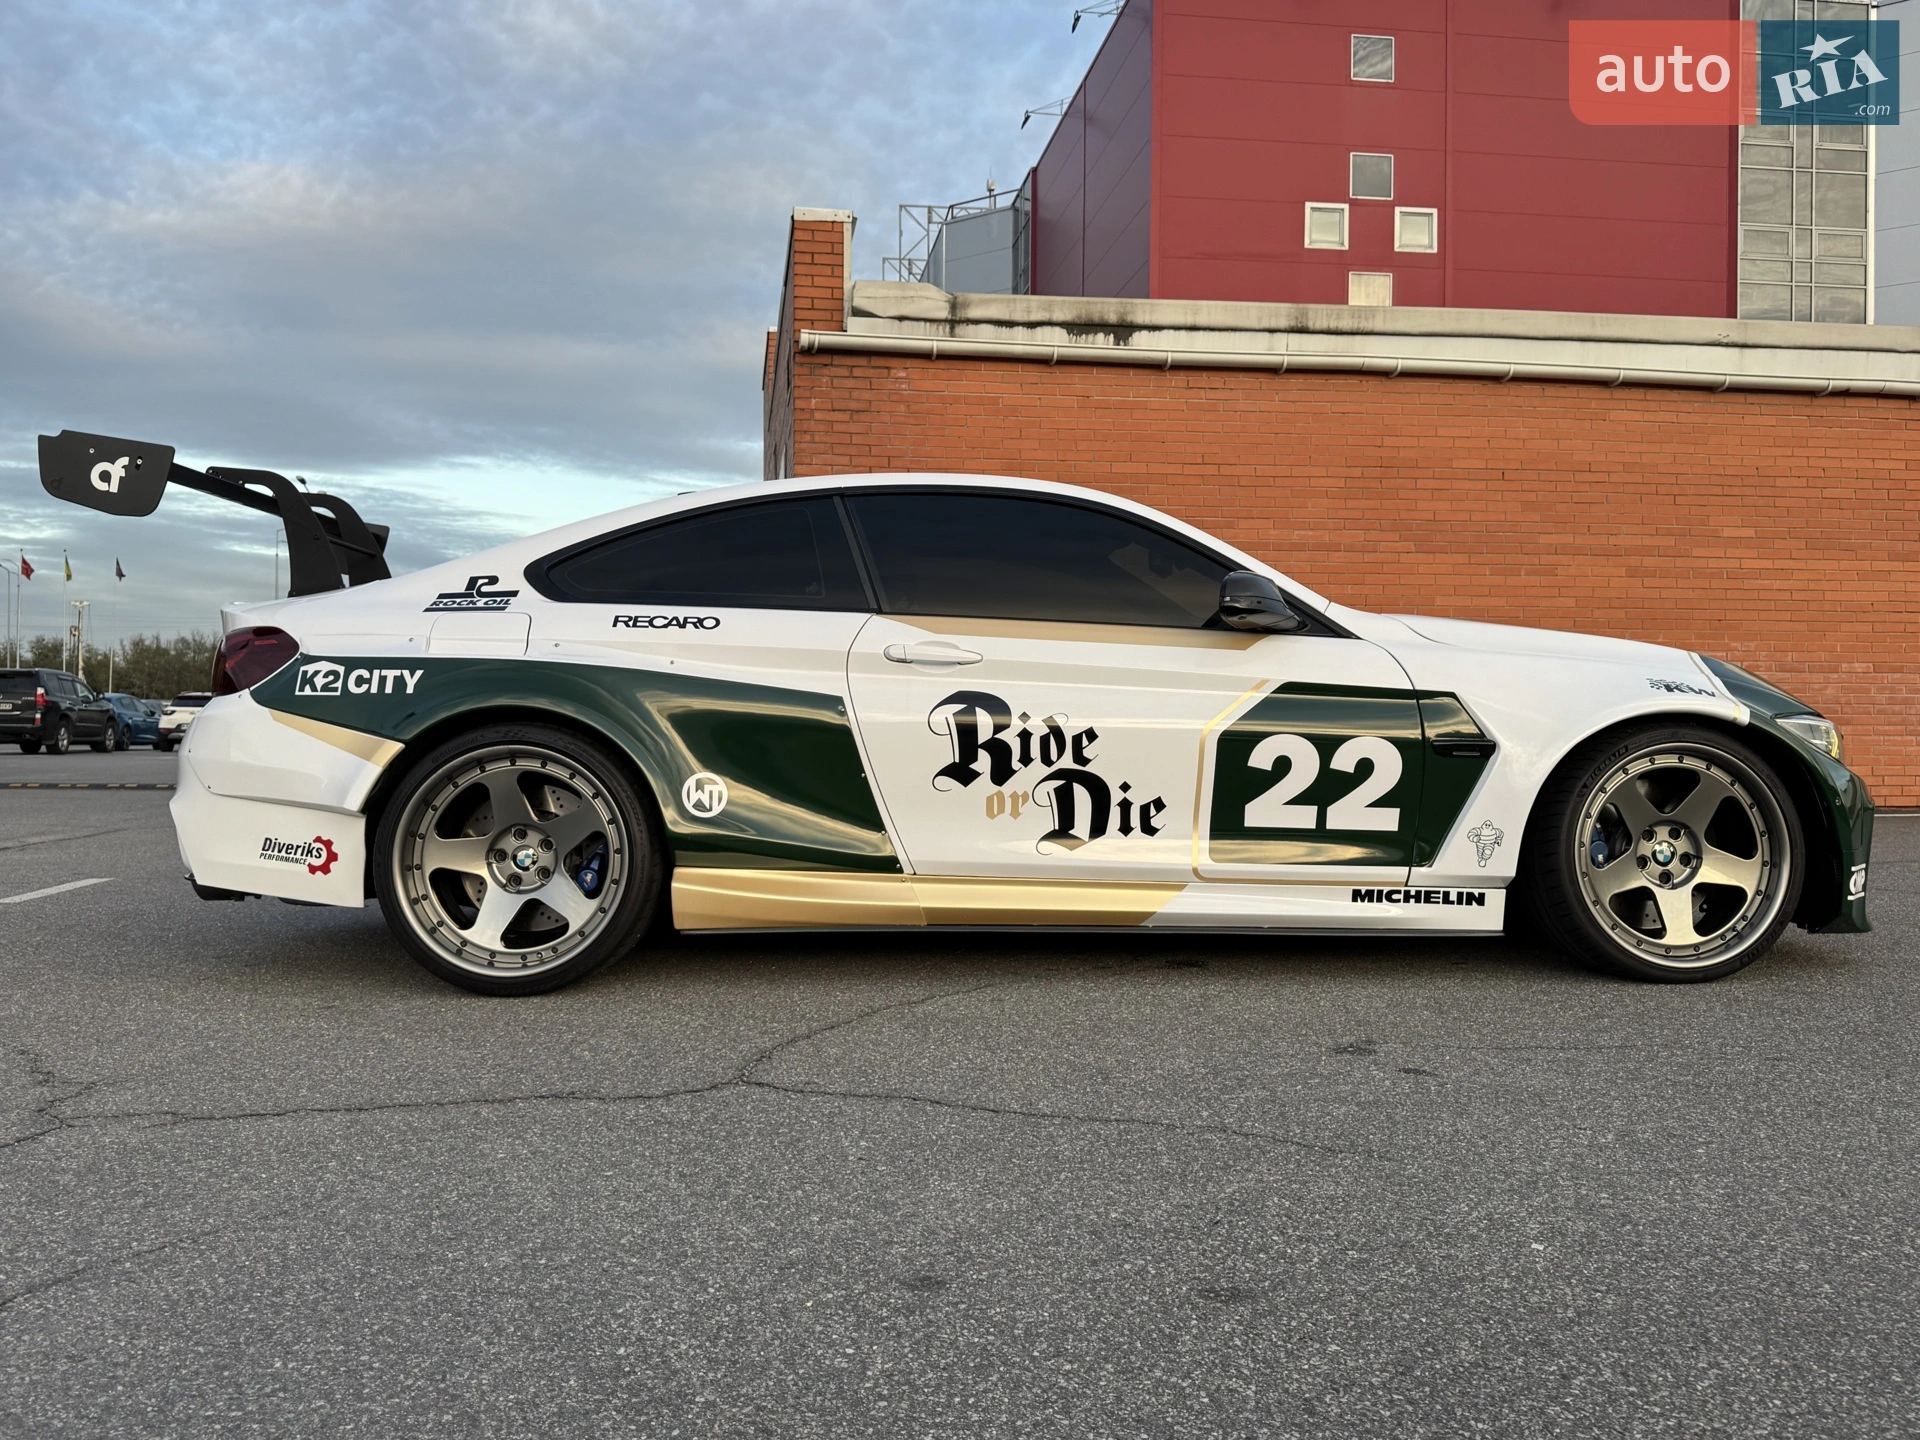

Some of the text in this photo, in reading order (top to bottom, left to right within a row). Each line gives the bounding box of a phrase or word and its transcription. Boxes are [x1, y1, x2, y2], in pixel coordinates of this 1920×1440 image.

[484, 598, 512, 606] OIL
[612, 615, 721, 630] RECARO
[297, 669, 424, 694] K2 CITY
[928, 690, 1099, 792] Ride
[1244, 733, 1403, 832] 22
[985, 768, 1167, 856] or Die
[261, 837, 324, 859] Diveriks
[259, 853, 307, 866] PERFORMANCE
[1351, 888, 1486, 906] MICHELIN
